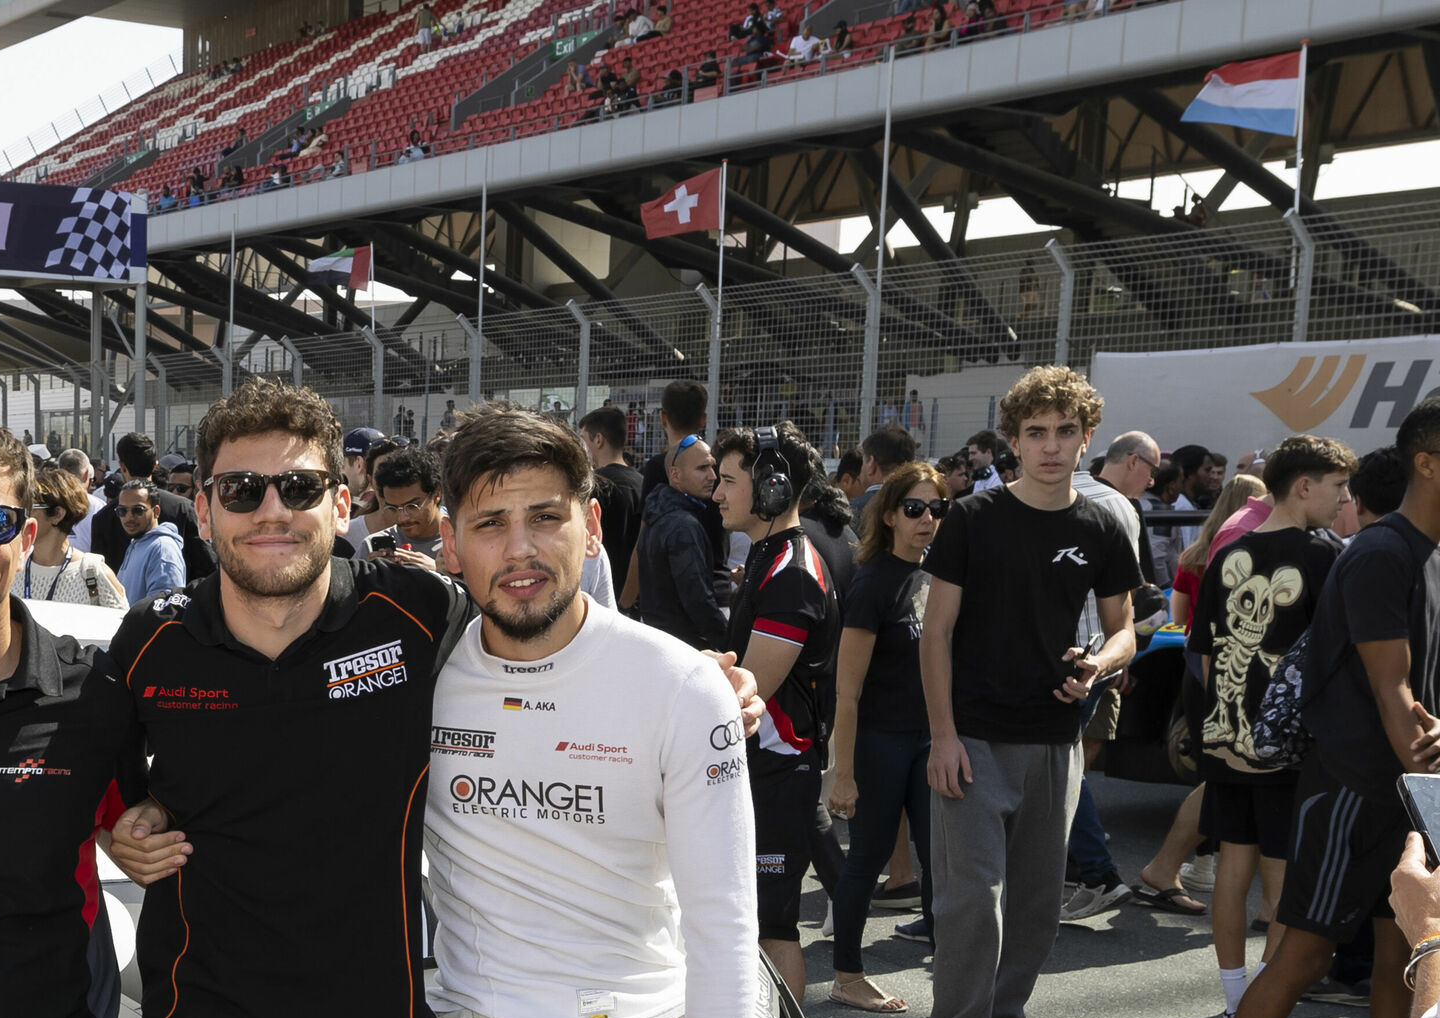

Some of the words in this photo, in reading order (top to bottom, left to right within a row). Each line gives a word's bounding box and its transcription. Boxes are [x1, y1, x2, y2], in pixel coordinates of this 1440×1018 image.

[323, 640, 404, 684] Tresor
[329, 665, 408, 699] ORANGE1
[158, 687, 186, 697] Audi
[190, 687, 229, 700] Sport
[523, 701, 534, 710] A.
[535, 701, 556, 711] AKA
[432, 726, 496, 749] Tresor
[568, 753, 607, 763] customer
[609, 755, 633, 765] racing
[570, 742, 595, 752] Audi
[597, 744, 628, 755] Sport
[450, 774, 605, 813] ORANGE1
[453, 803, 528, 819] ELECTRIC
[537, 808, 606, 824] MOTORS
